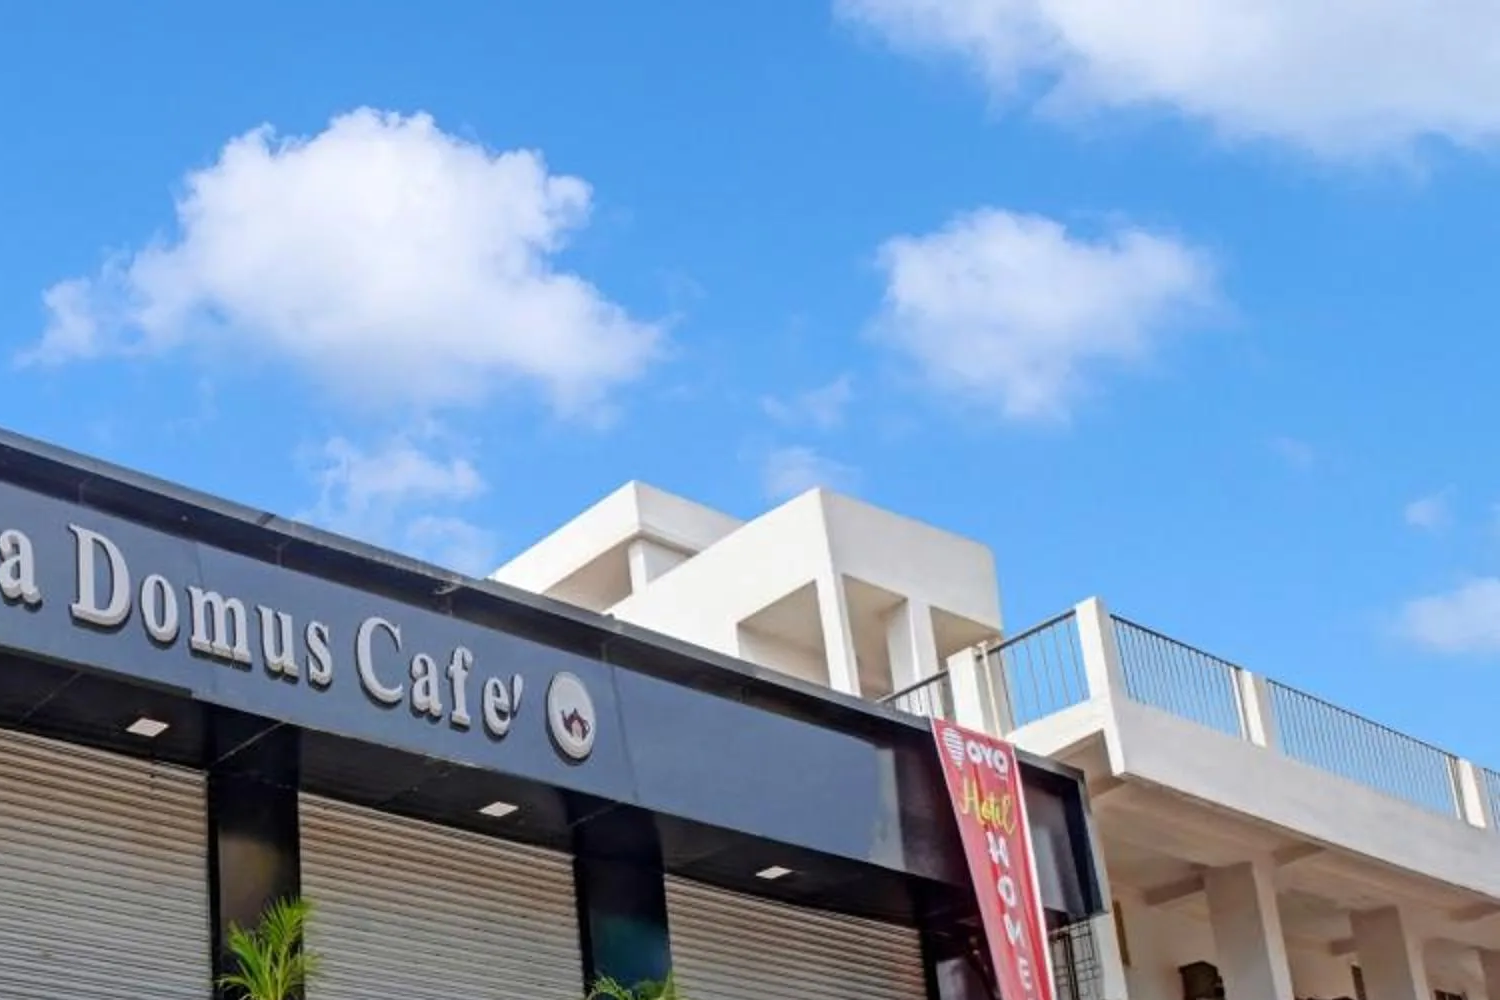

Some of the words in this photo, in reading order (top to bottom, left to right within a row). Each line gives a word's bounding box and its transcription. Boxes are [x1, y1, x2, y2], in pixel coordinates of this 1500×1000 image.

[68, 522, 333, 687] Domus
[966, 739, 1009, 774] OYO
[959, 775, 1017, 836] Hotel
